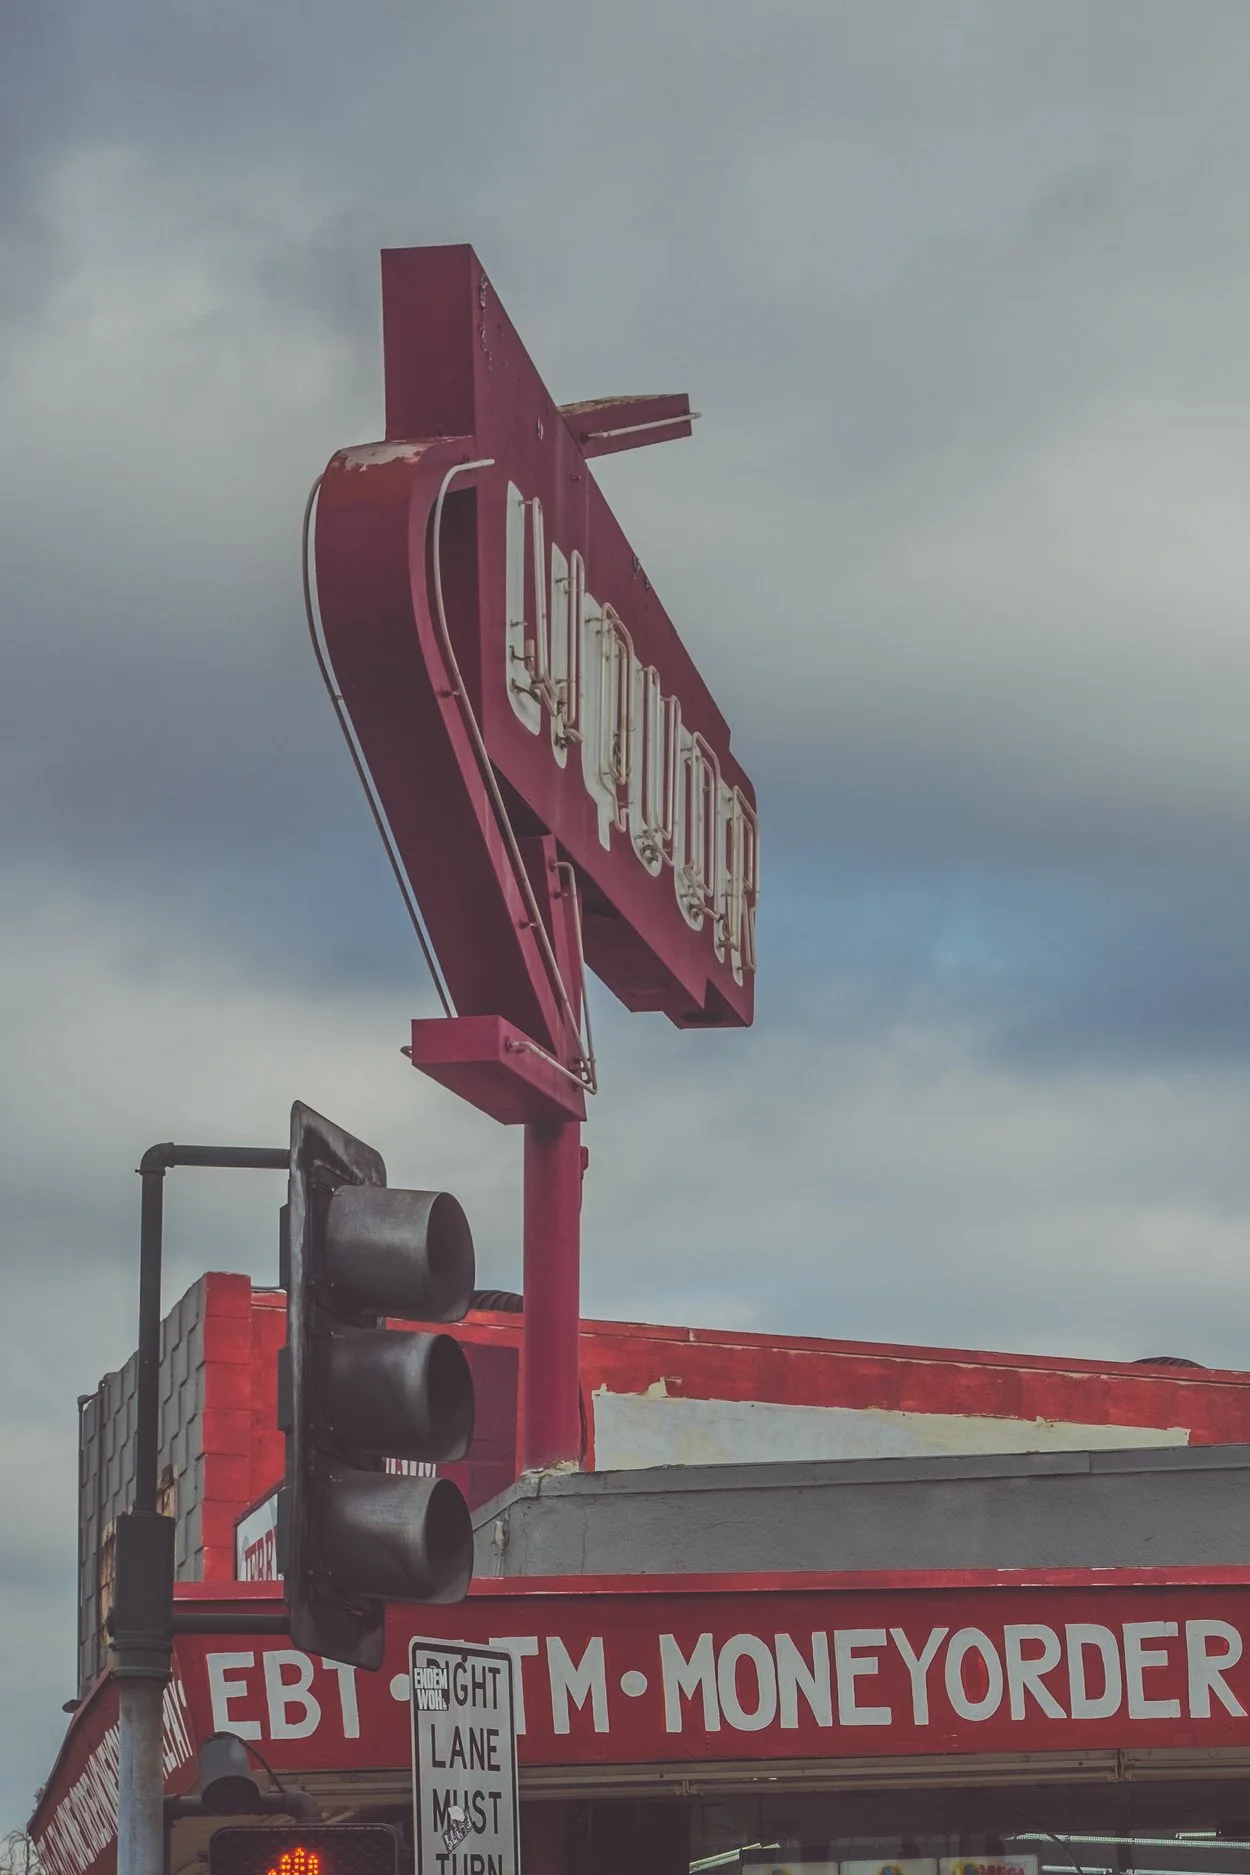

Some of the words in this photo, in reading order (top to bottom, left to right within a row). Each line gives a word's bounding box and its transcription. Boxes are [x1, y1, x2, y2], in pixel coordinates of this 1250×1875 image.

[206, 1649, 362, 1740] EBT
[489, 1636, 609, 1738] TM
[426, 1657, 501, 1710] IGHT
[430, 1723, 501, 1772] LANE
